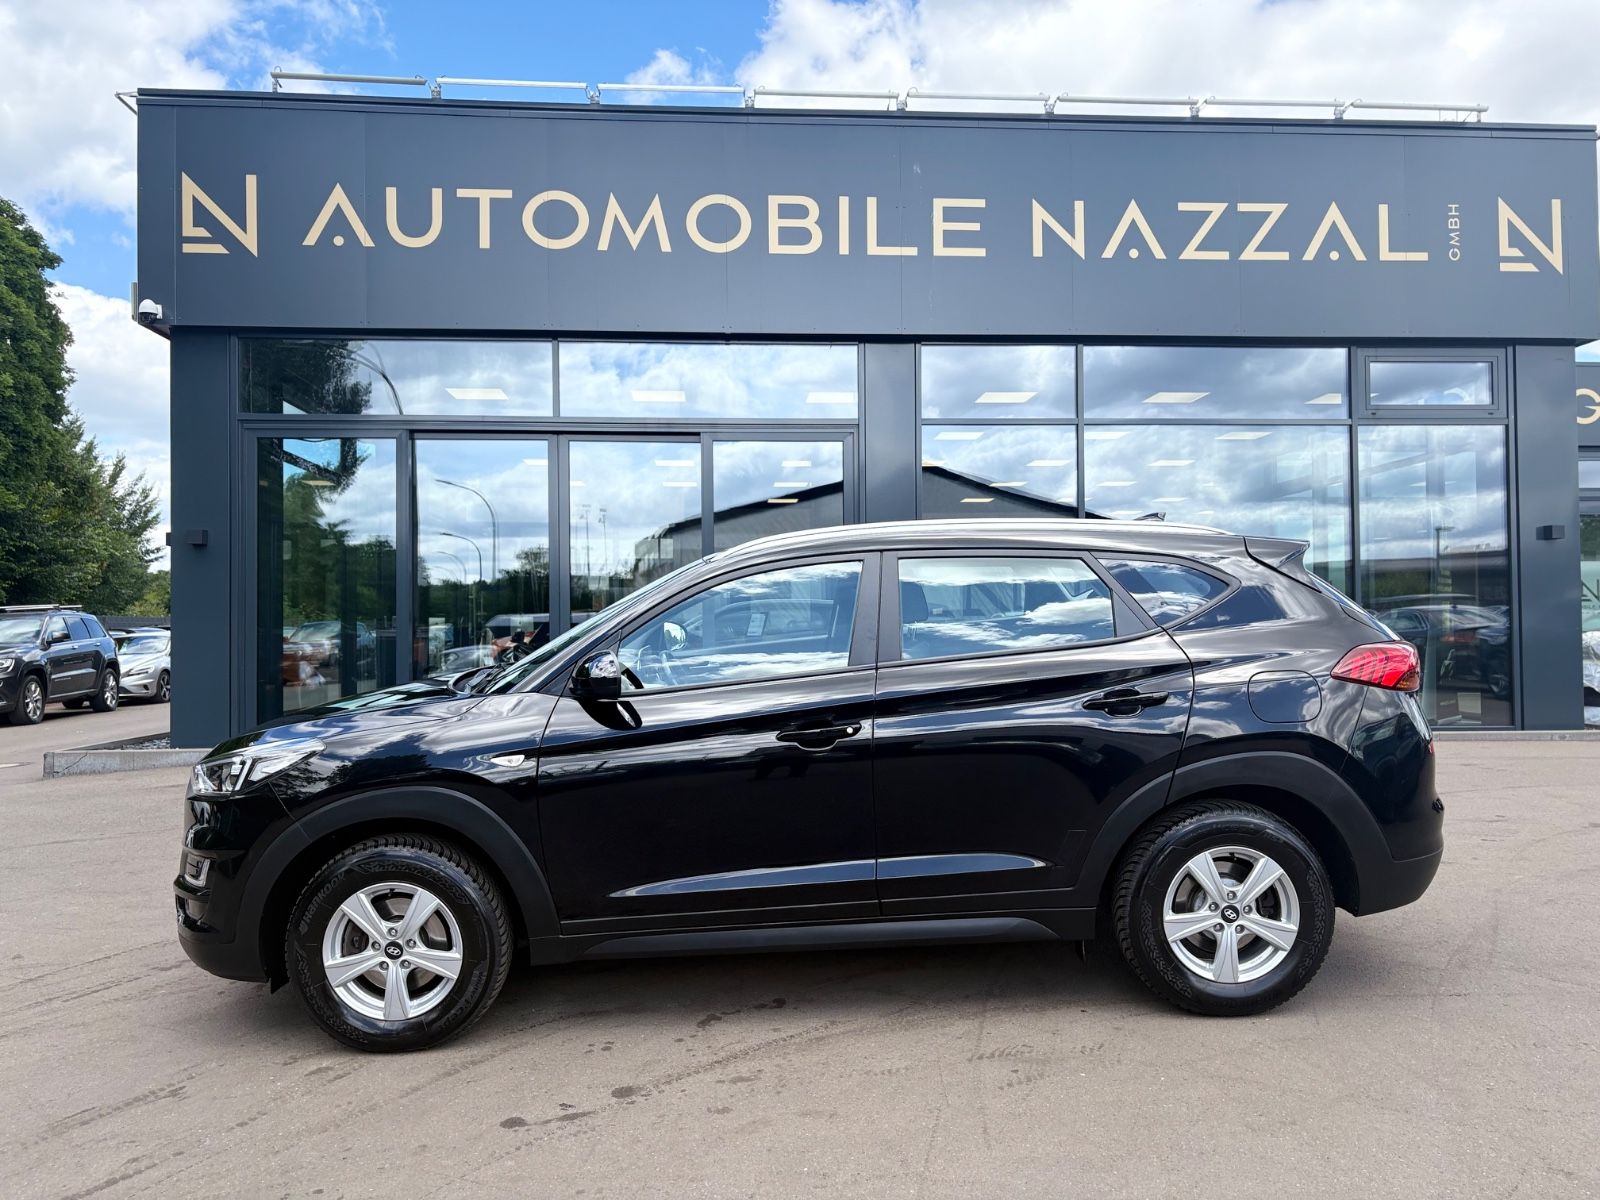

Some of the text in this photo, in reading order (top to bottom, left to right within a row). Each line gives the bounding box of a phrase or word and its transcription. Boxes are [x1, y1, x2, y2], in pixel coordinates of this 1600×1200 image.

[302, 182, 1461, 261] AUTOMOBILE NAZZAL GMBH
